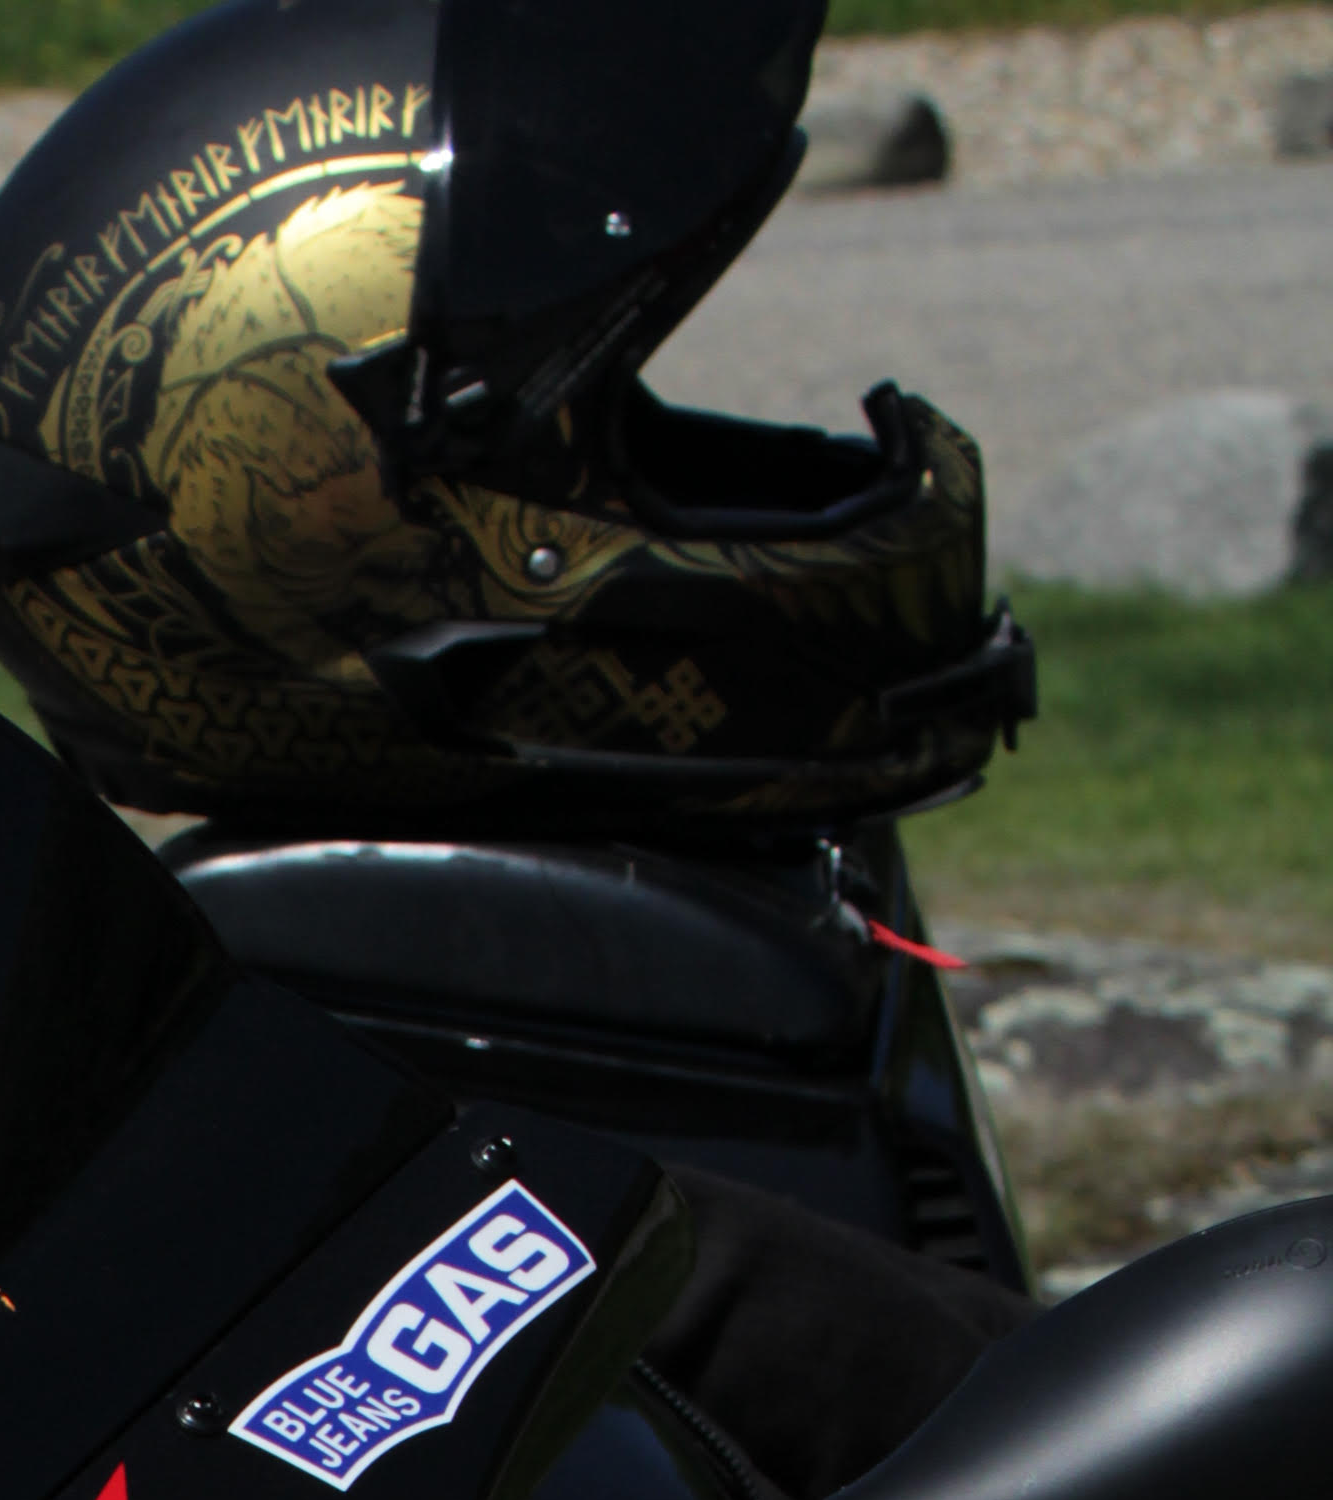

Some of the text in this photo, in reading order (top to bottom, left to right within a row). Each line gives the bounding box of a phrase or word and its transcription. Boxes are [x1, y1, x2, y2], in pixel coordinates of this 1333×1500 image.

[367, 1213, 570, 1394] GAS
[262, 1365, 370, 1443] BLUE
[308, 1388, 422, 1469] JEANS
